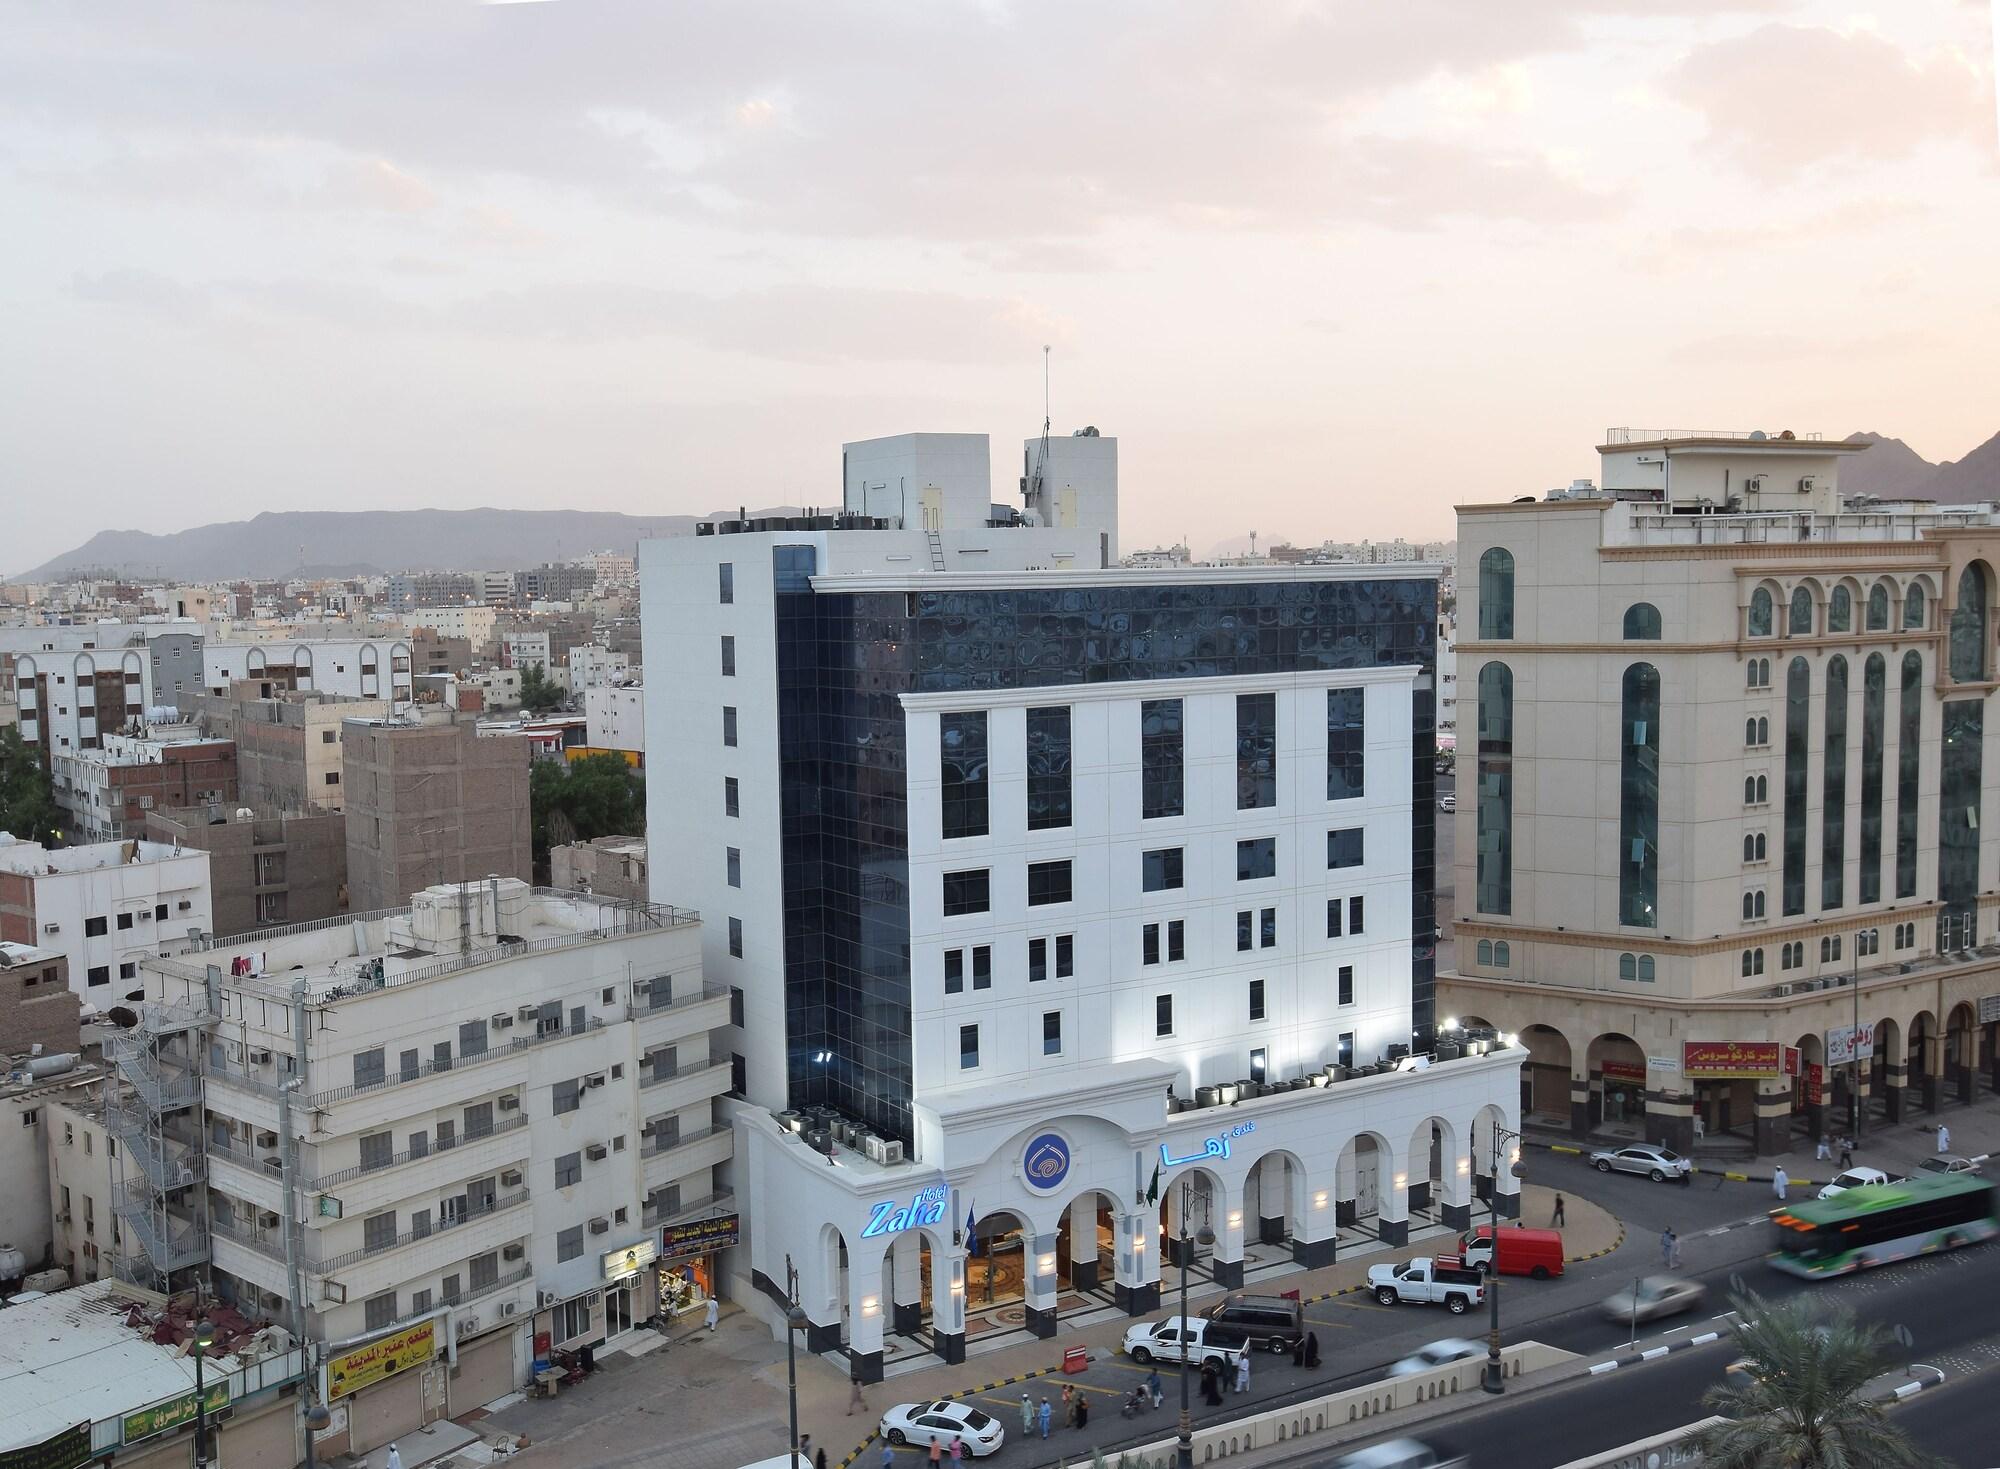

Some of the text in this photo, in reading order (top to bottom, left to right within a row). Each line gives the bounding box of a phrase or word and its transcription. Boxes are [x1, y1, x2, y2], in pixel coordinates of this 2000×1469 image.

[920, 1184, 948, 1202] Hotel
[861, 1195, 946, 1239] Zaha
[406, 1328, 433, 1349] مطعم
[183, 1395, 201, 1418] ركز
